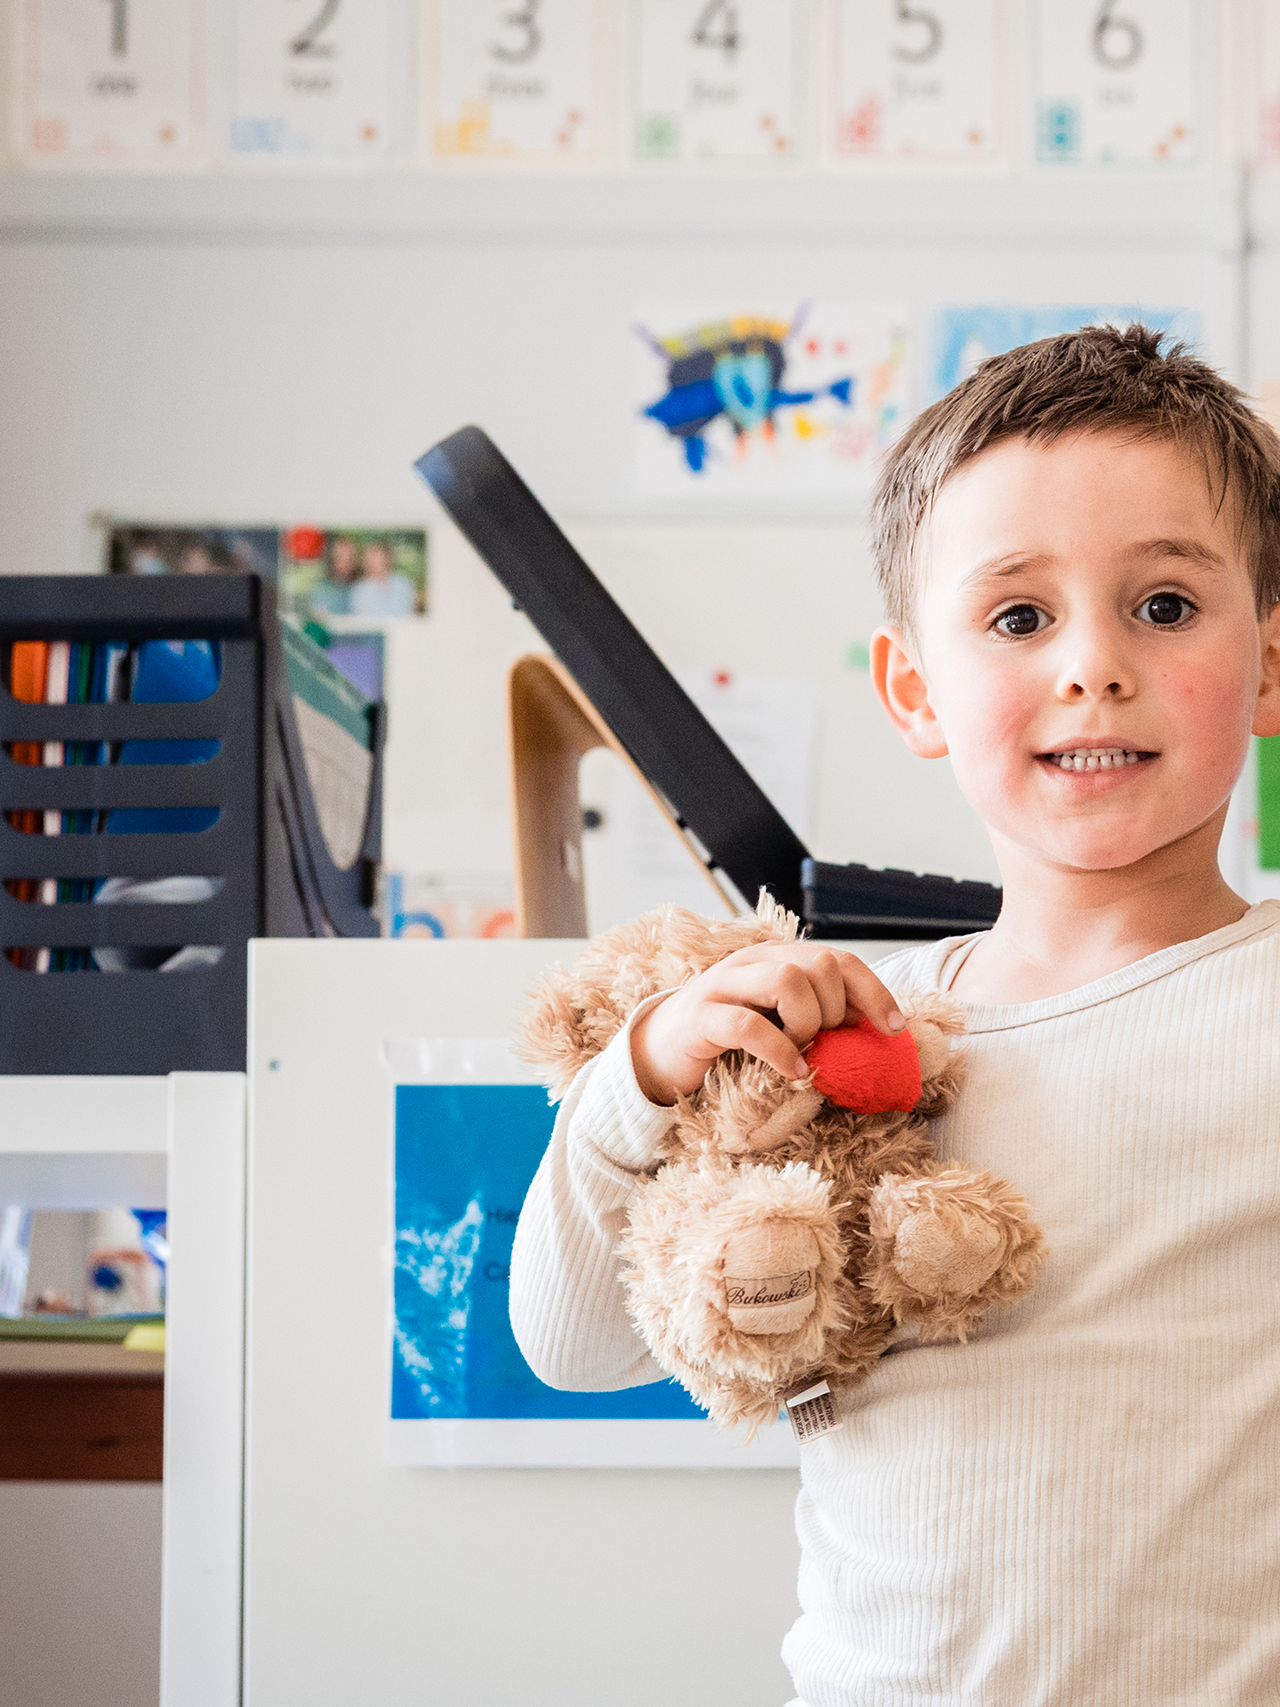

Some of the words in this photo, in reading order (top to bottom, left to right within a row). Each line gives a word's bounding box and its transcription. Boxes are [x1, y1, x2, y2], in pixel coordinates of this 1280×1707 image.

[104, 0, 130, 59] 1
[288, 0, 338, 59] 2
[488, 0, 542, 64] 3
[688, 0, 742, 65] 4
[895, 0, 944, 65] 5
[1090, 0, 1144, 71] 6
[726, 1281, 804, 1305] Bukowski
